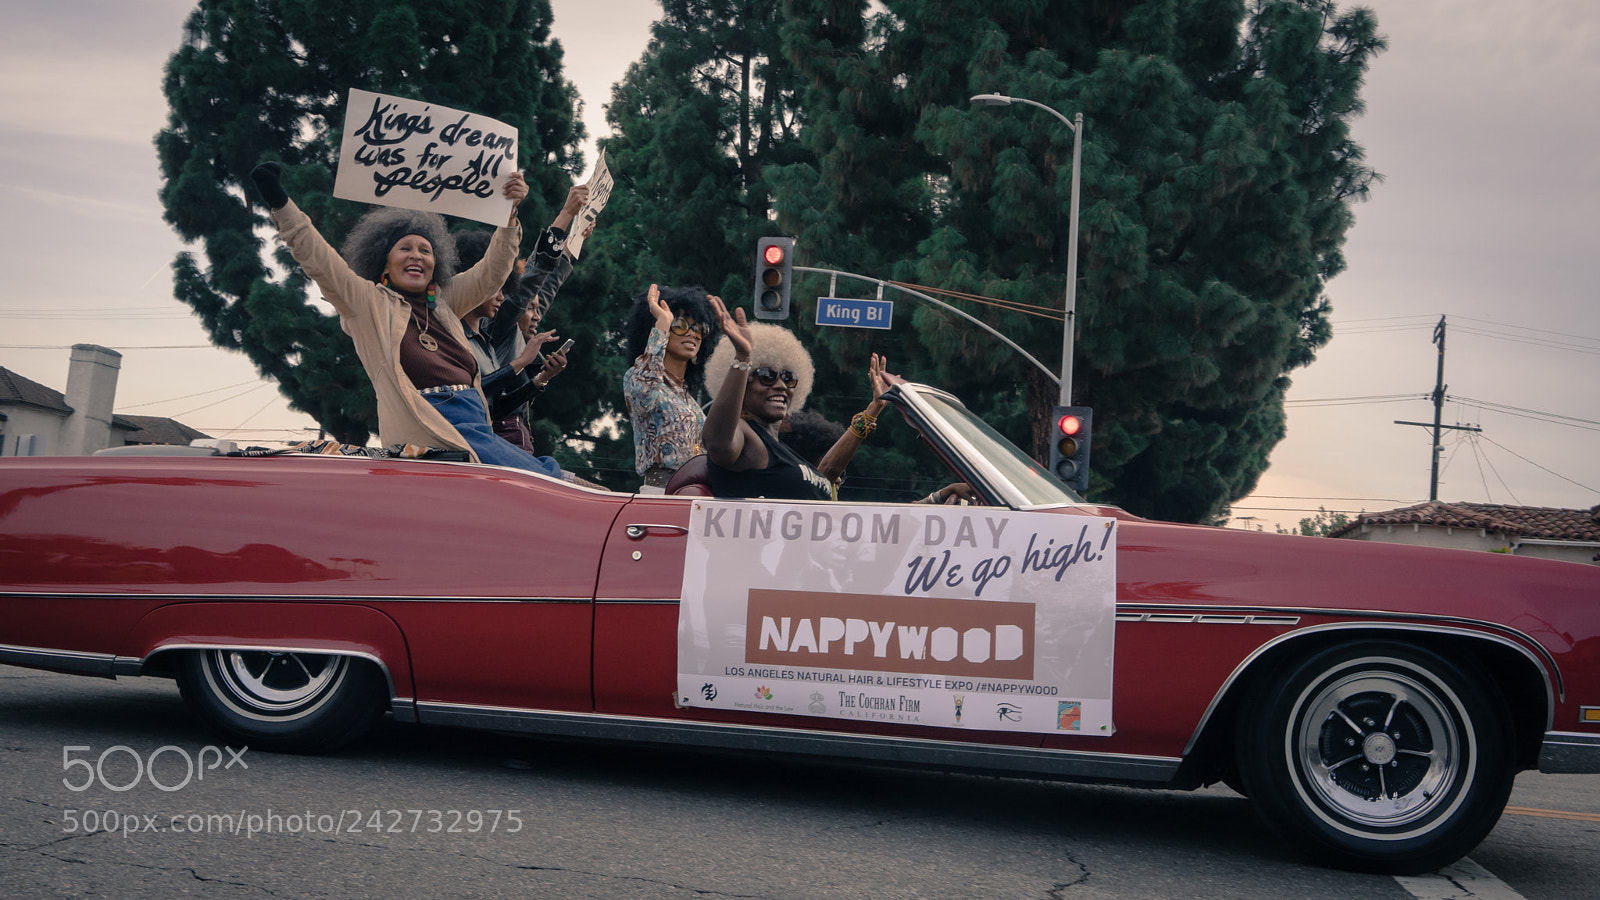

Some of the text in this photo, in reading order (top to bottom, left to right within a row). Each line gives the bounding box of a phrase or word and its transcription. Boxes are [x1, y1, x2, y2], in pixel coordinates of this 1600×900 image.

[439, 114, 515, 160] dream
[417, 142, 452, 170] for
[463, 150, 502, 178] All
[826, 304, 883, 323] King Bl
[703, 507, 1010, 549] KINGDOM DAY
[904, 520, 1116, 597] We go high!
[758, 615, 1024, 664] NAPPYWOOD
[725, 667, 745, 677] LOS
[747, 668, 794, 680] ANGELES
[797, 671, 845, 683] NATURAL
[848, 674, 874, 685] HAIR
[876, 676, 884, 685] &
[886, 677, 941, 689] LIFESTYLE
[944, 680, 973, 691] EXPO
[839, 709, 920, 722] CALIFORNIA
